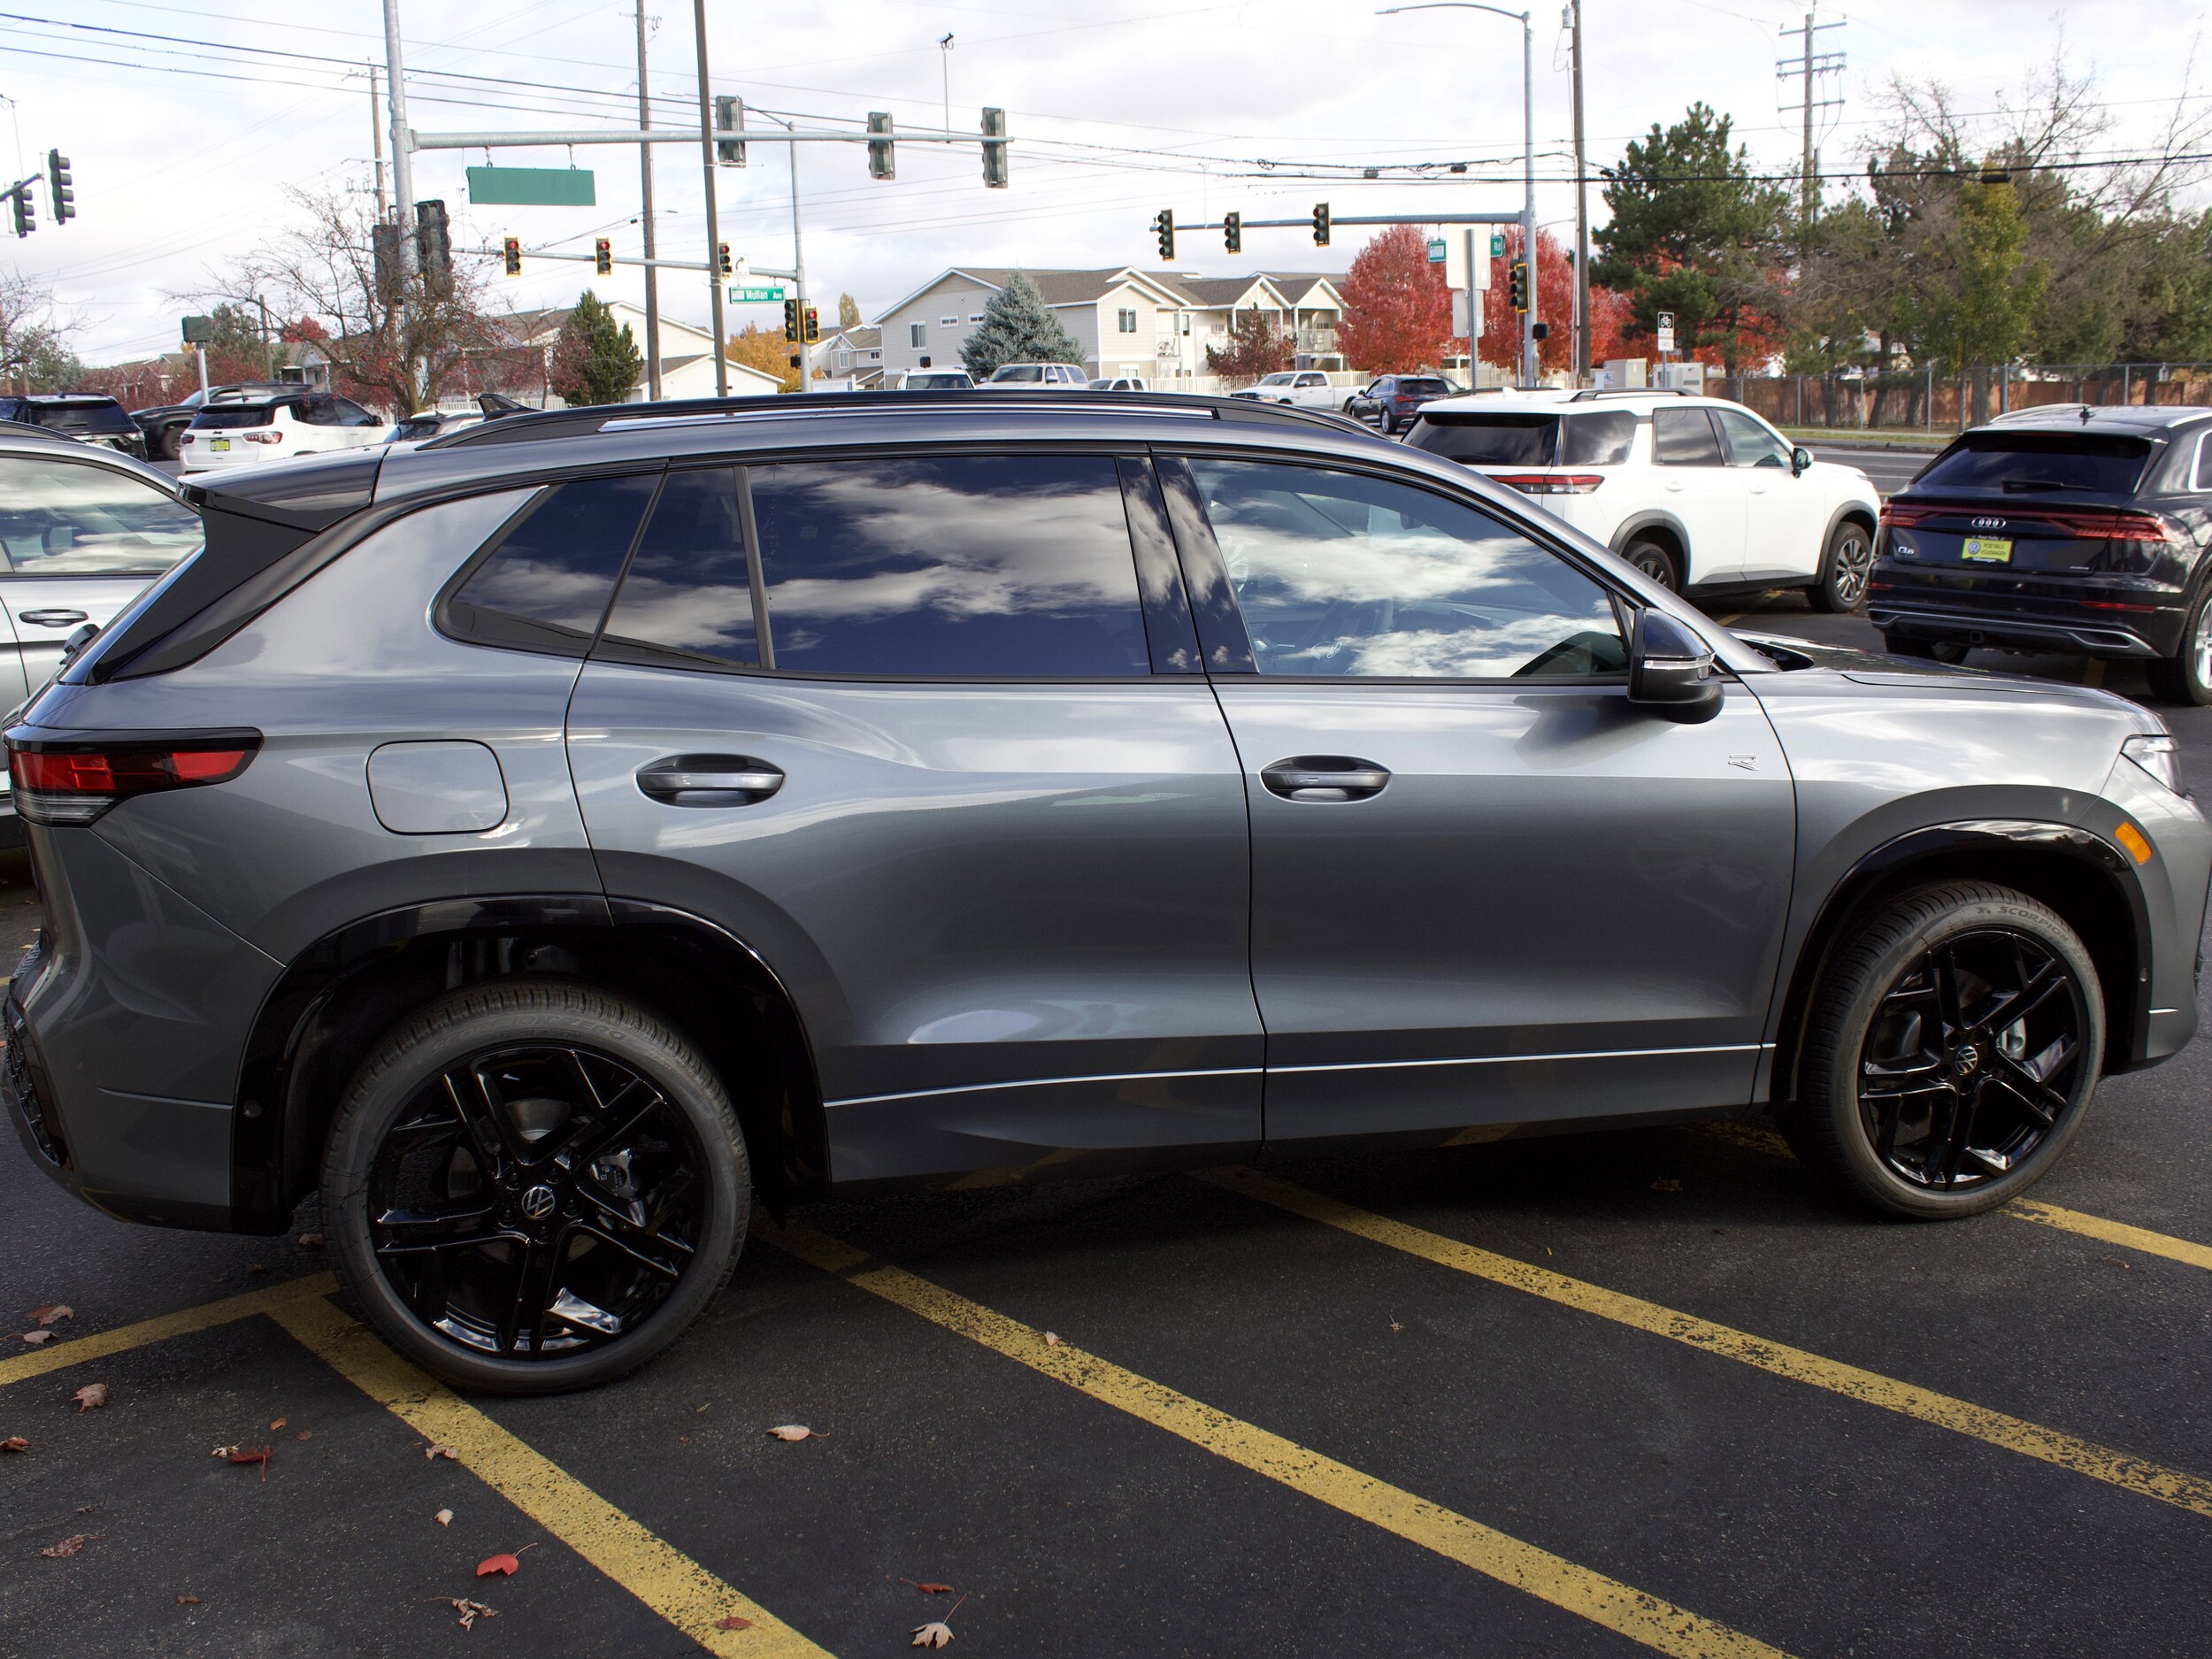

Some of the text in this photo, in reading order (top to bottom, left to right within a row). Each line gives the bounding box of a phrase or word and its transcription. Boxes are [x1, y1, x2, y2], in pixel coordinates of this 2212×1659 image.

[1494, 242, 1502, 252] Rd
[746, 289, 768, 300] Mullan
[772, 291, 783, 300] Ave
[1998, 906, 2069, 943] SCORPION
